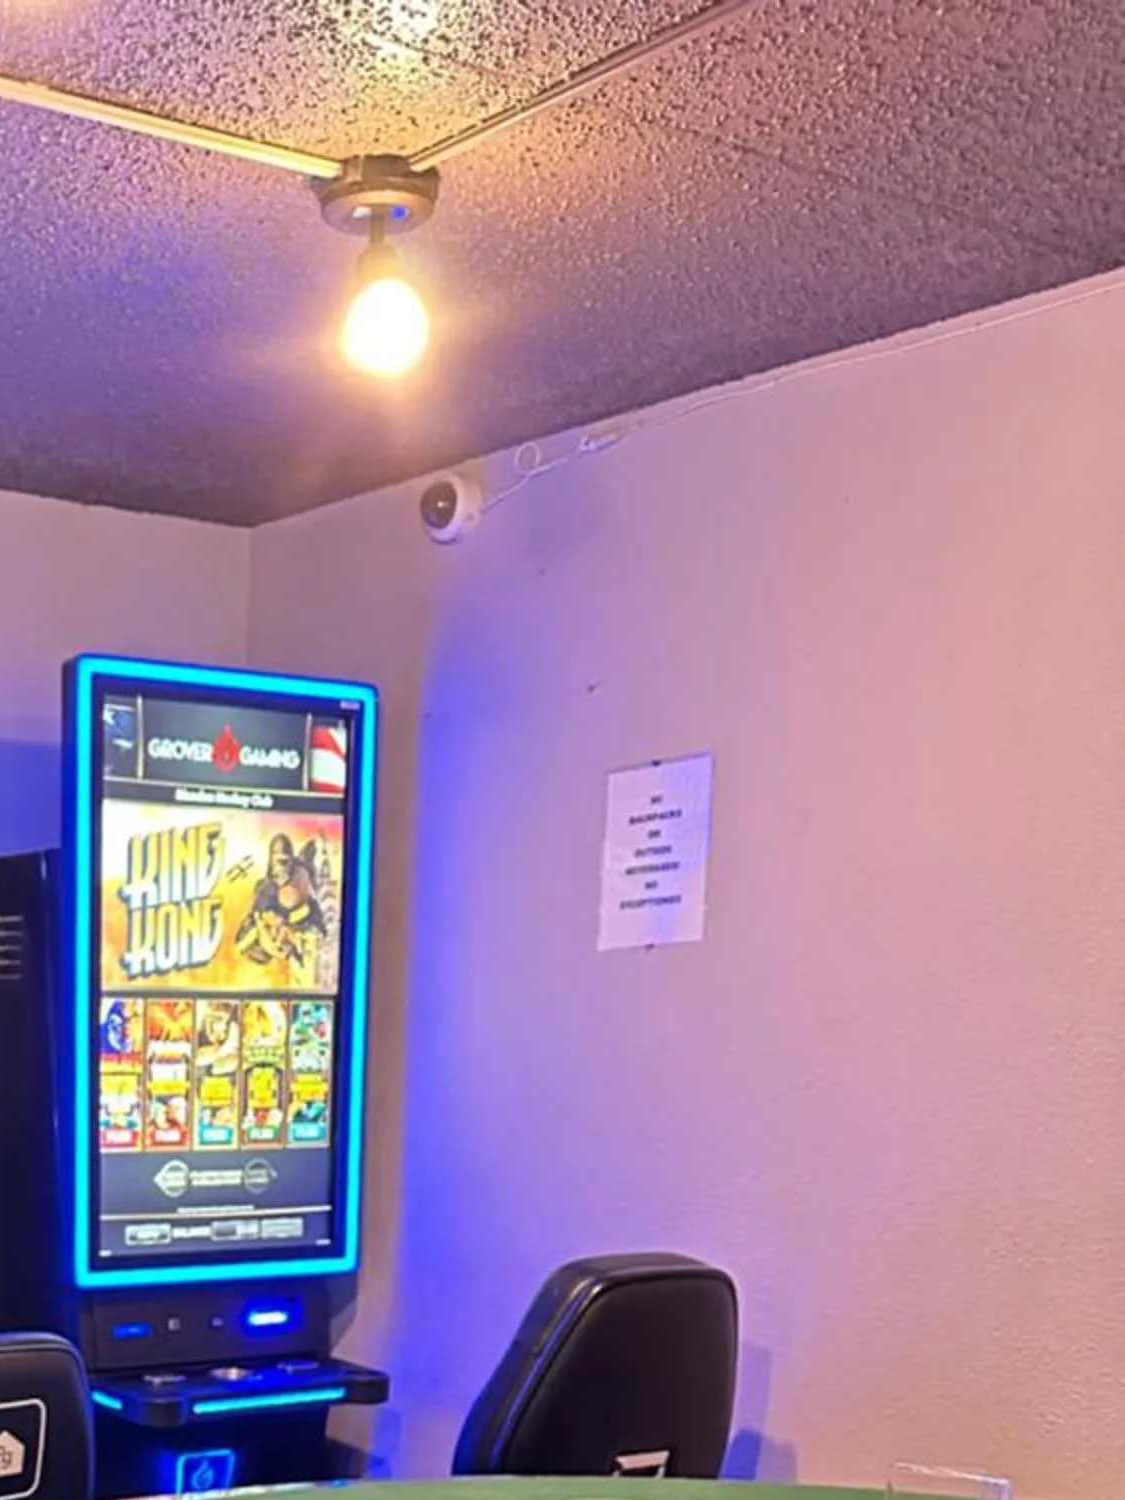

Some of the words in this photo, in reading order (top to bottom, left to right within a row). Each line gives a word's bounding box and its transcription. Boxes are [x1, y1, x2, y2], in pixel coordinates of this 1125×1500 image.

[147, 736, 214, 763] GROVER
[239, 746, 300, 769] GAMING
[117, 823, 225, 908] KING
[118, 897, 226, 981] KONG
